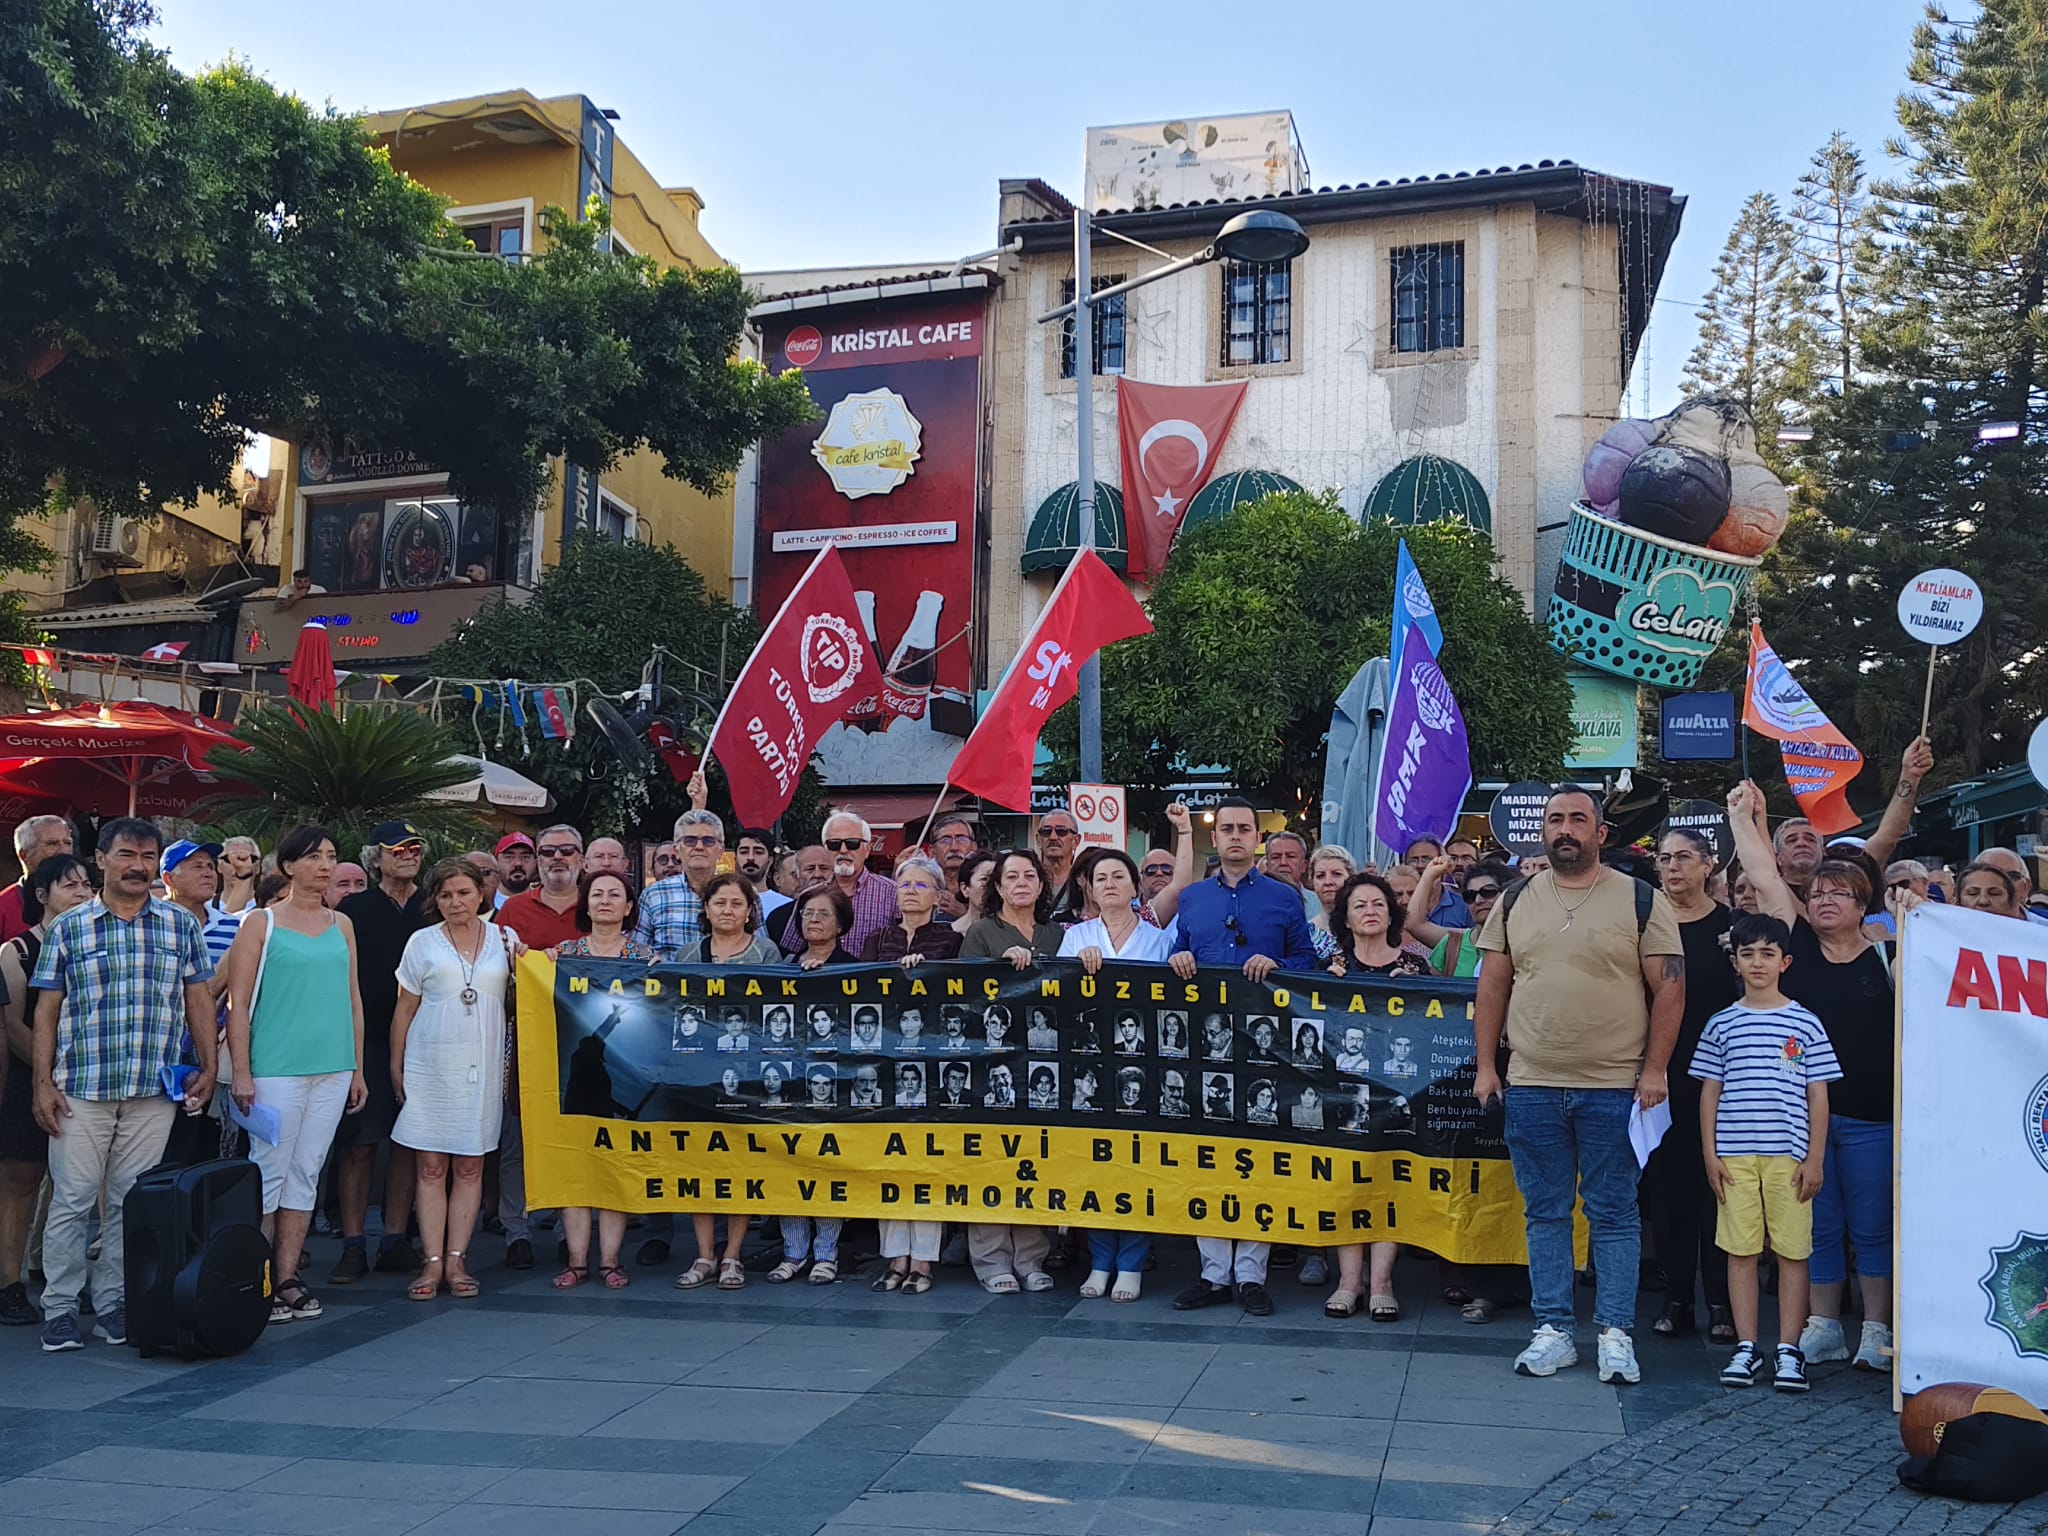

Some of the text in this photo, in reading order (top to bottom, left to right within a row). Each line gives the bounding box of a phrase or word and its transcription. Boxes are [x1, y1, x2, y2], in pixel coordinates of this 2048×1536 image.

[831, 321, 972, 354] KRİSTAL CAFE
[836, 441, 901, 465] cafe kristal
[781, 536, 805, 545] LATTE
[858, 530, 899, 541] ESPRESSO
[903, 529, 917, 537] ICE
[918, 527, 948, 537] COFFEE
[1916, 580, 1974, 601] KATLİAMLAR
[1930, 596, 1951, 614] BİZİ
[1909, 612, 1965, 633] YILDIRAMAZ
[816, 630, 845, 670] TİP
[1668, 713, 1730, 729] LAVAZZA
[6, 734, 146, 749] Gerçek Mucize
[1501, 795, 1549, 806] MADIMA
[1669, 813, 1724, 827] MADIMAK
[569, 976, 799, 997] MADIMAK
[841, 977, 1000, 1001] UTANÇ
[1040, 975, 1228, 1005] MÜZESİ
[1431, 1033, 1472, 1048] Ateşteki
[1431, 1052, 1462, 1067] Dönüp
[1443, 1066, 1459, 1081] taş
[1428, 1085, 1447, 1096] Bak
[1449, 1087, 1460, 1099] şu
[1427, 1103, 1446, 1115] Ben
[1447, 1104, 1459, 1116] bu
[2031, 1127, 2047, 1153] HACI
[593, 1126, 1480, 1194] ANTALYA ALEVİ BİLEŞENLERİ
[1015, 1159, 1039, 1182] &
[645, 1177, 1397, 1233] EMEK VE DEMOKRASİ GÜÇLERİ
[2001, 1259, 2020, 1286] ABDAL
[2017, 1245, 2042, 1262] MUSA
